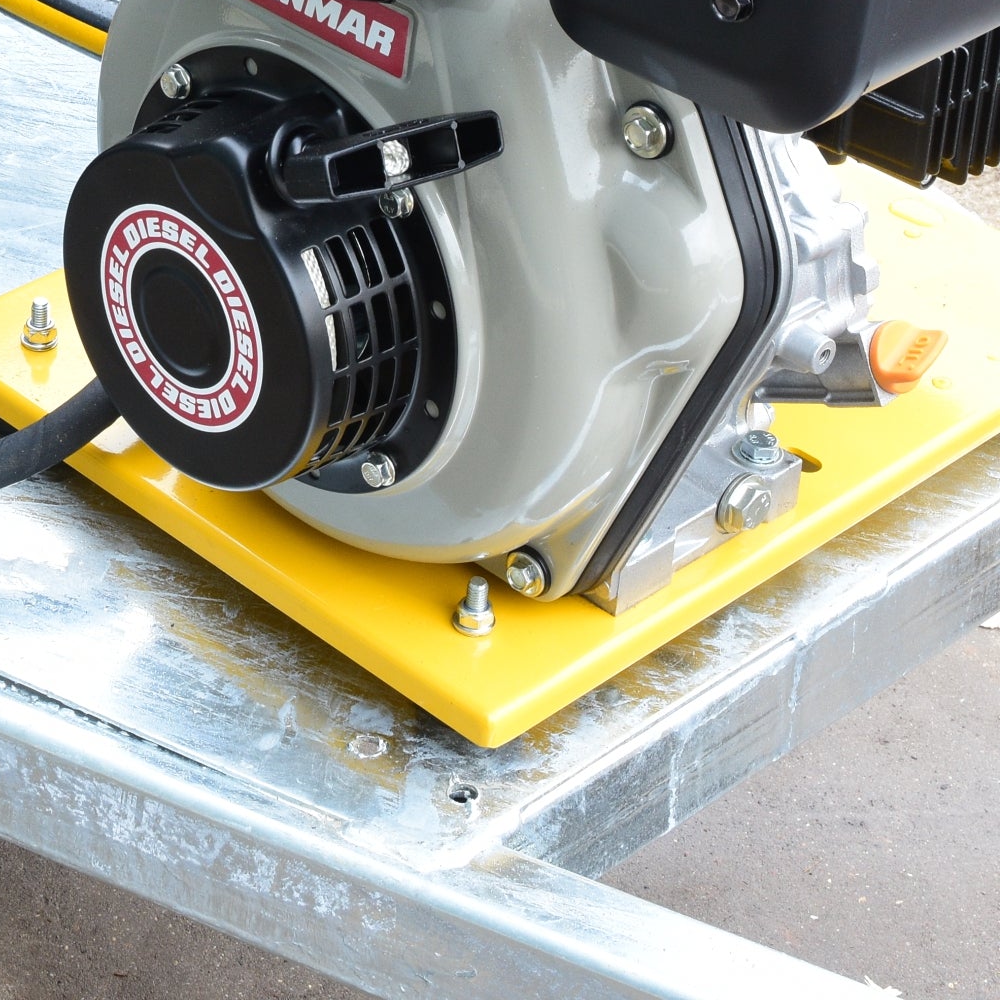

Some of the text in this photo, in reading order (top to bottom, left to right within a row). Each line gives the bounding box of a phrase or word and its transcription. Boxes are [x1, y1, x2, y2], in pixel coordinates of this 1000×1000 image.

[123, 217, 210, 268] DIESEL
[109, 245, 146, 364] DIESEL
[213, 269, 254, 394] DIESEL
[149, 364, 236, 419] DIESEL
